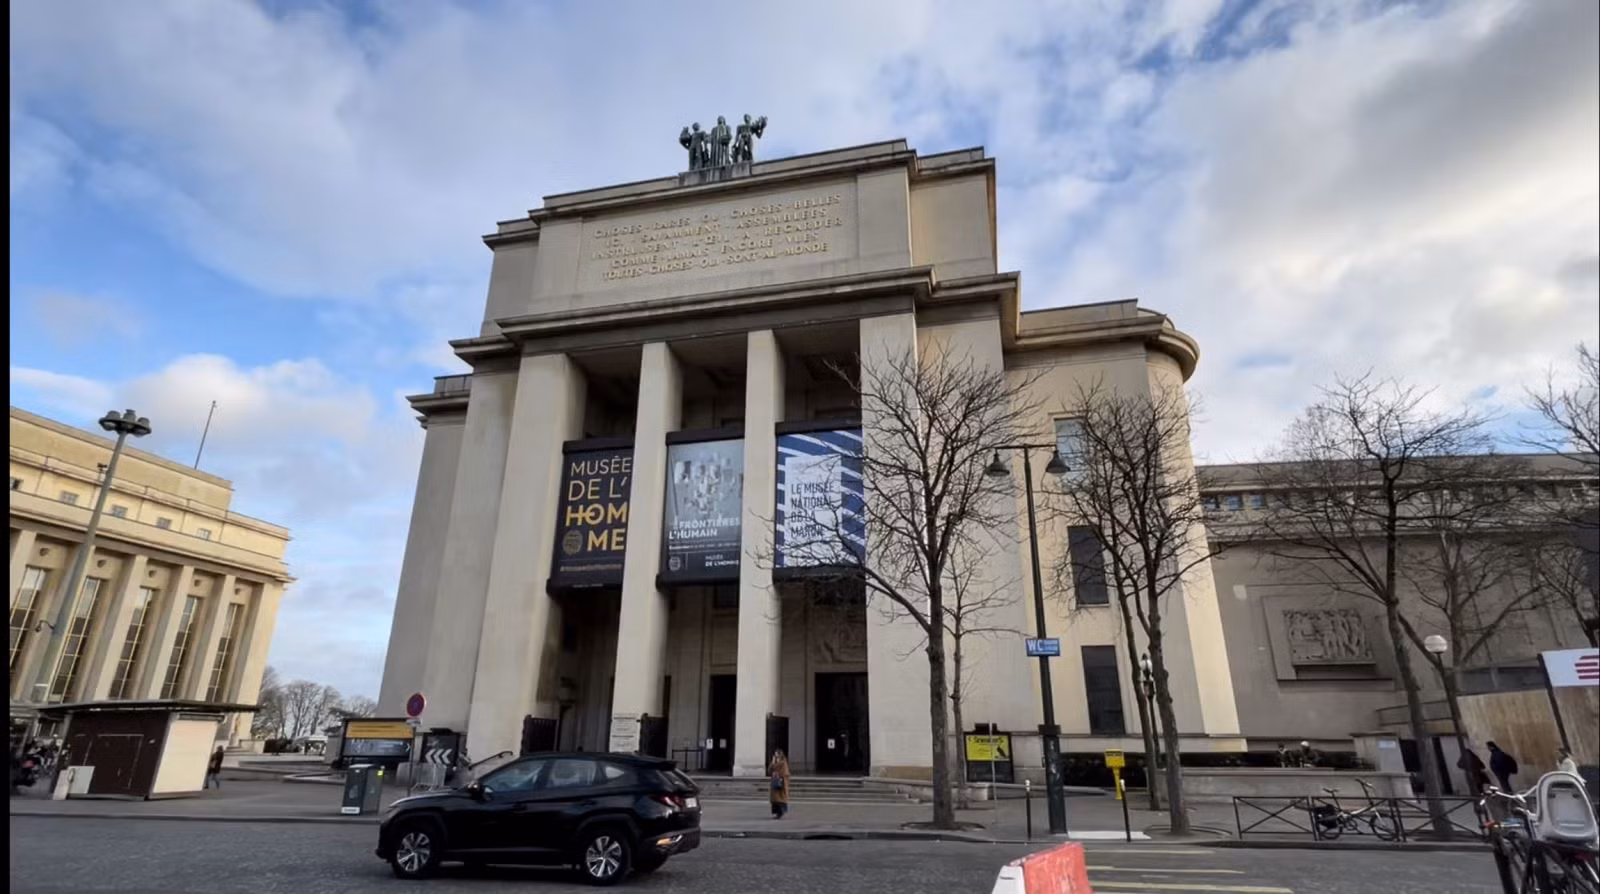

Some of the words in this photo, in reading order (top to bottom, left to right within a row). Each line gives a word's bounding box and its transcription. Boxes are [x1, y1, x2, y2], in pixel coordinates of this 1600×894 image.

[731, 203, 782, 219] CHOSES
[795, 194, 841, 210] BELLES
[764, 216, 842, 237] REGARDER
[785, 241, 829, 256] MONDE
[571, 455, 633, 477] MUSÉE
[568, 478, 602, 502] DE
[609, 476, 628, 499] L'
[791, 483, 801, 495] LE
[565, 501, 628, 527] HOM
[587, 528, 626, 552] ME
[669, 528, 718, 540] L'HUMAIN
[1027, 639, 1044, 652] WC
